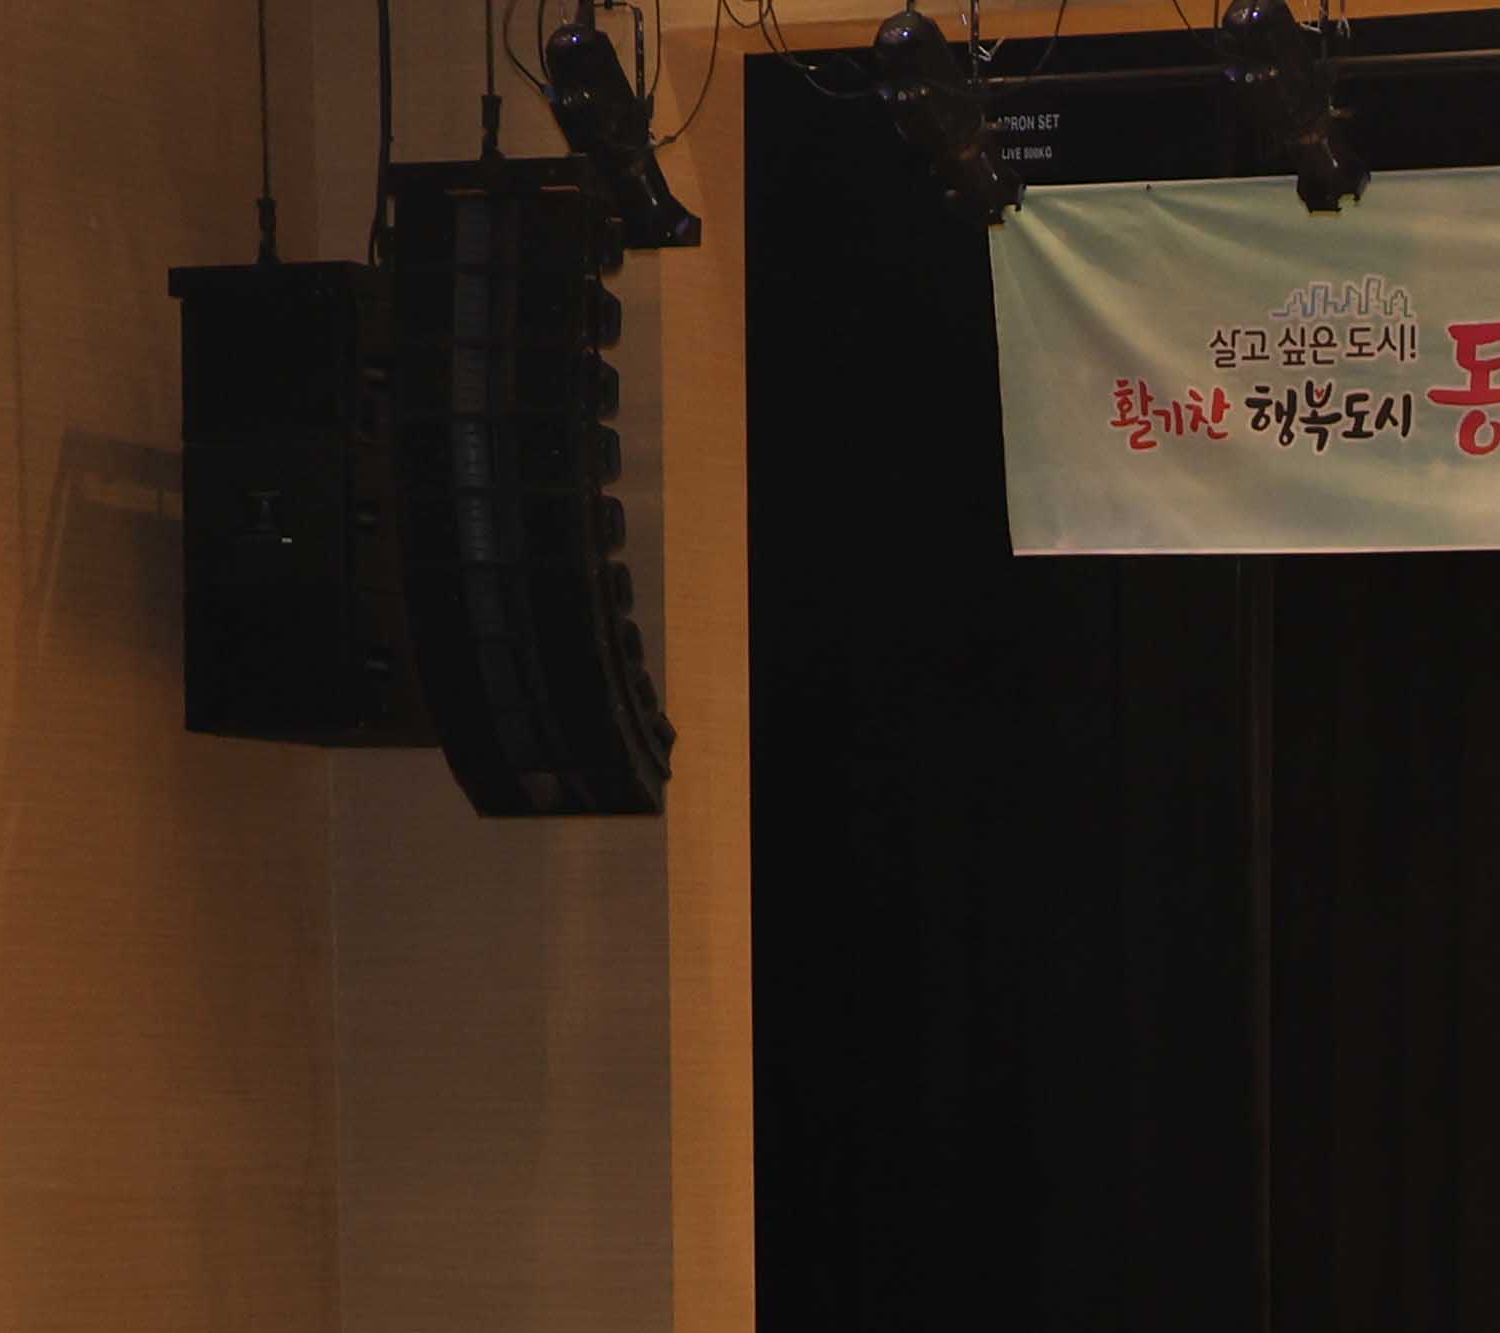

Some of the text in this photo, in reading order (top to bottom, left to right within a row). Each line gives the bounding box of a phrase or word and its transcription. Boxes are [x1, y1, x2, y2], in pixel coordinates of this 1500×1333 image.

[1037, 113, 1060, 129] SET
[1209, 324, 1417, 368] 살고 싶은 도시!
[1110, 379, 1231, 450] 활기찬
[1244, 380, 1413, 452] 행복도시
